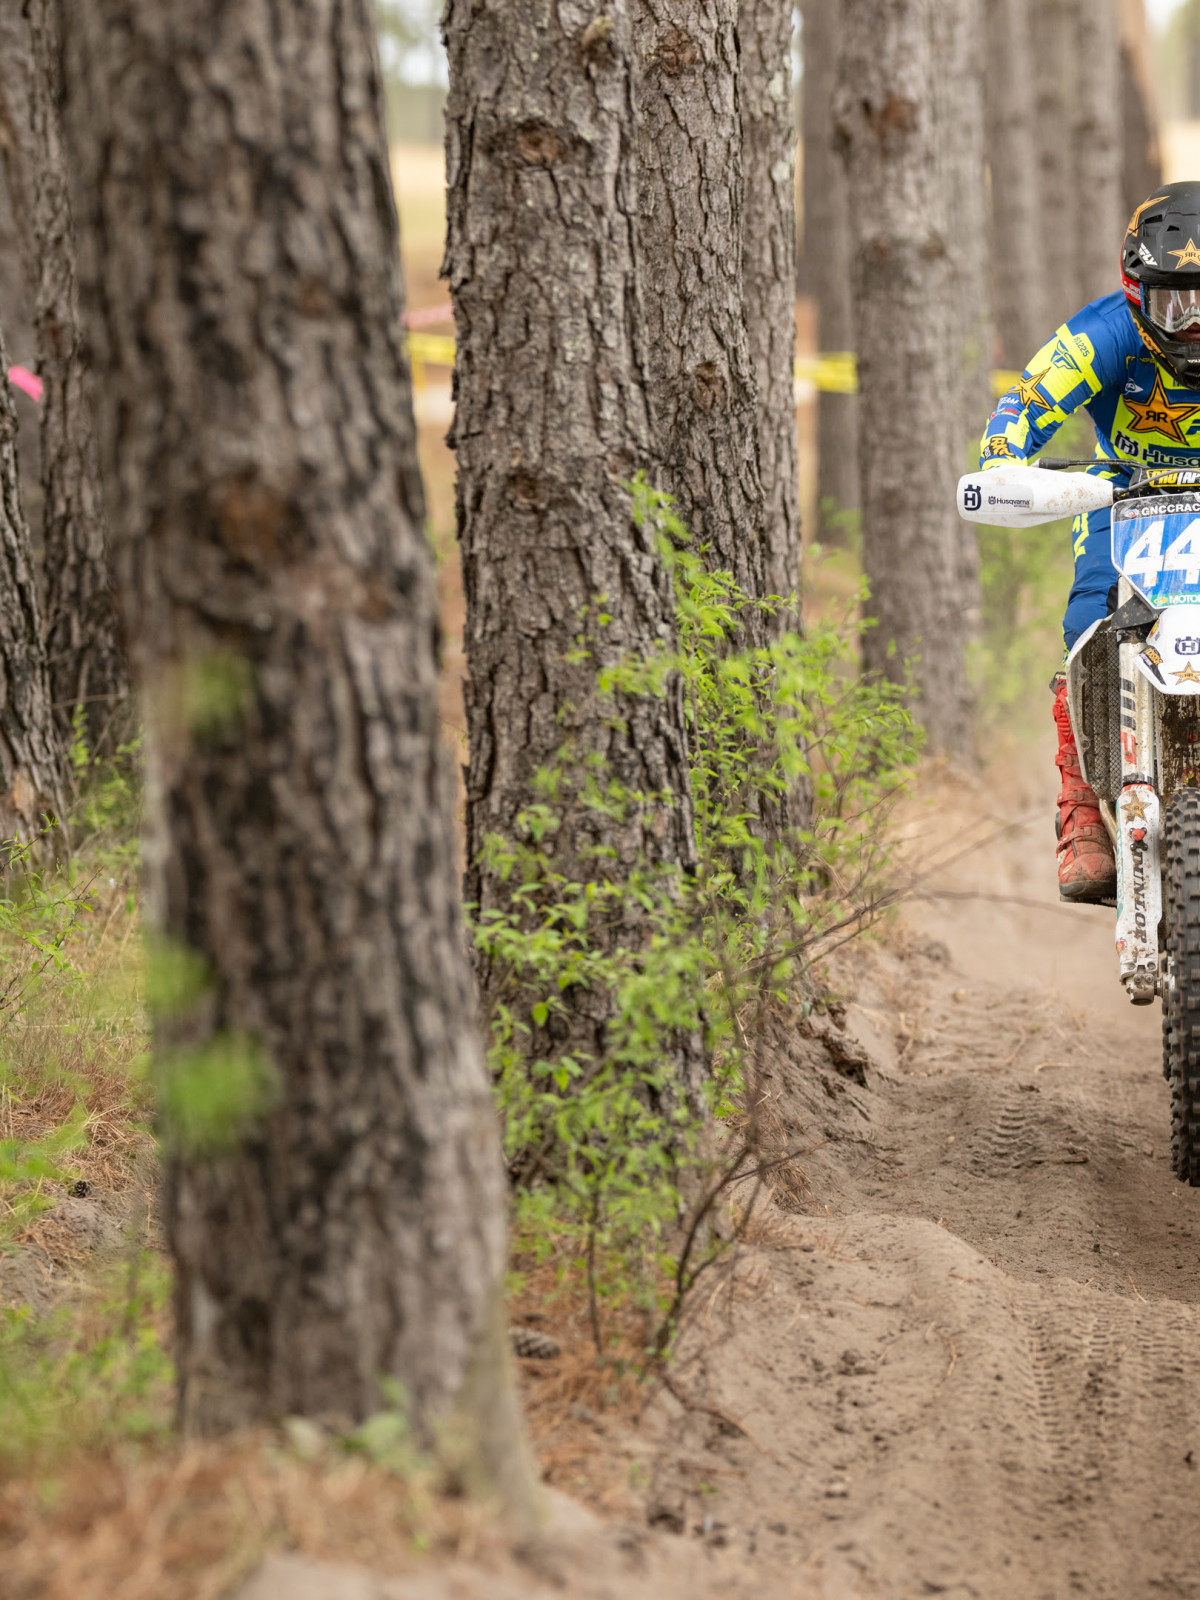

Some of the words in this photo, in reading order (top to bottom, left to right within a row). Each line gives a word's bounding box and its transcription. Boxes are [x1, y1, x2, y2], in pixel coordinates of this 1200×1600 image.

[1138, 242, 1158, 266] FLY
[996, 497, 1030, 506] Husqvarna
[1132, 851, 1147, 944] DUNLOP
